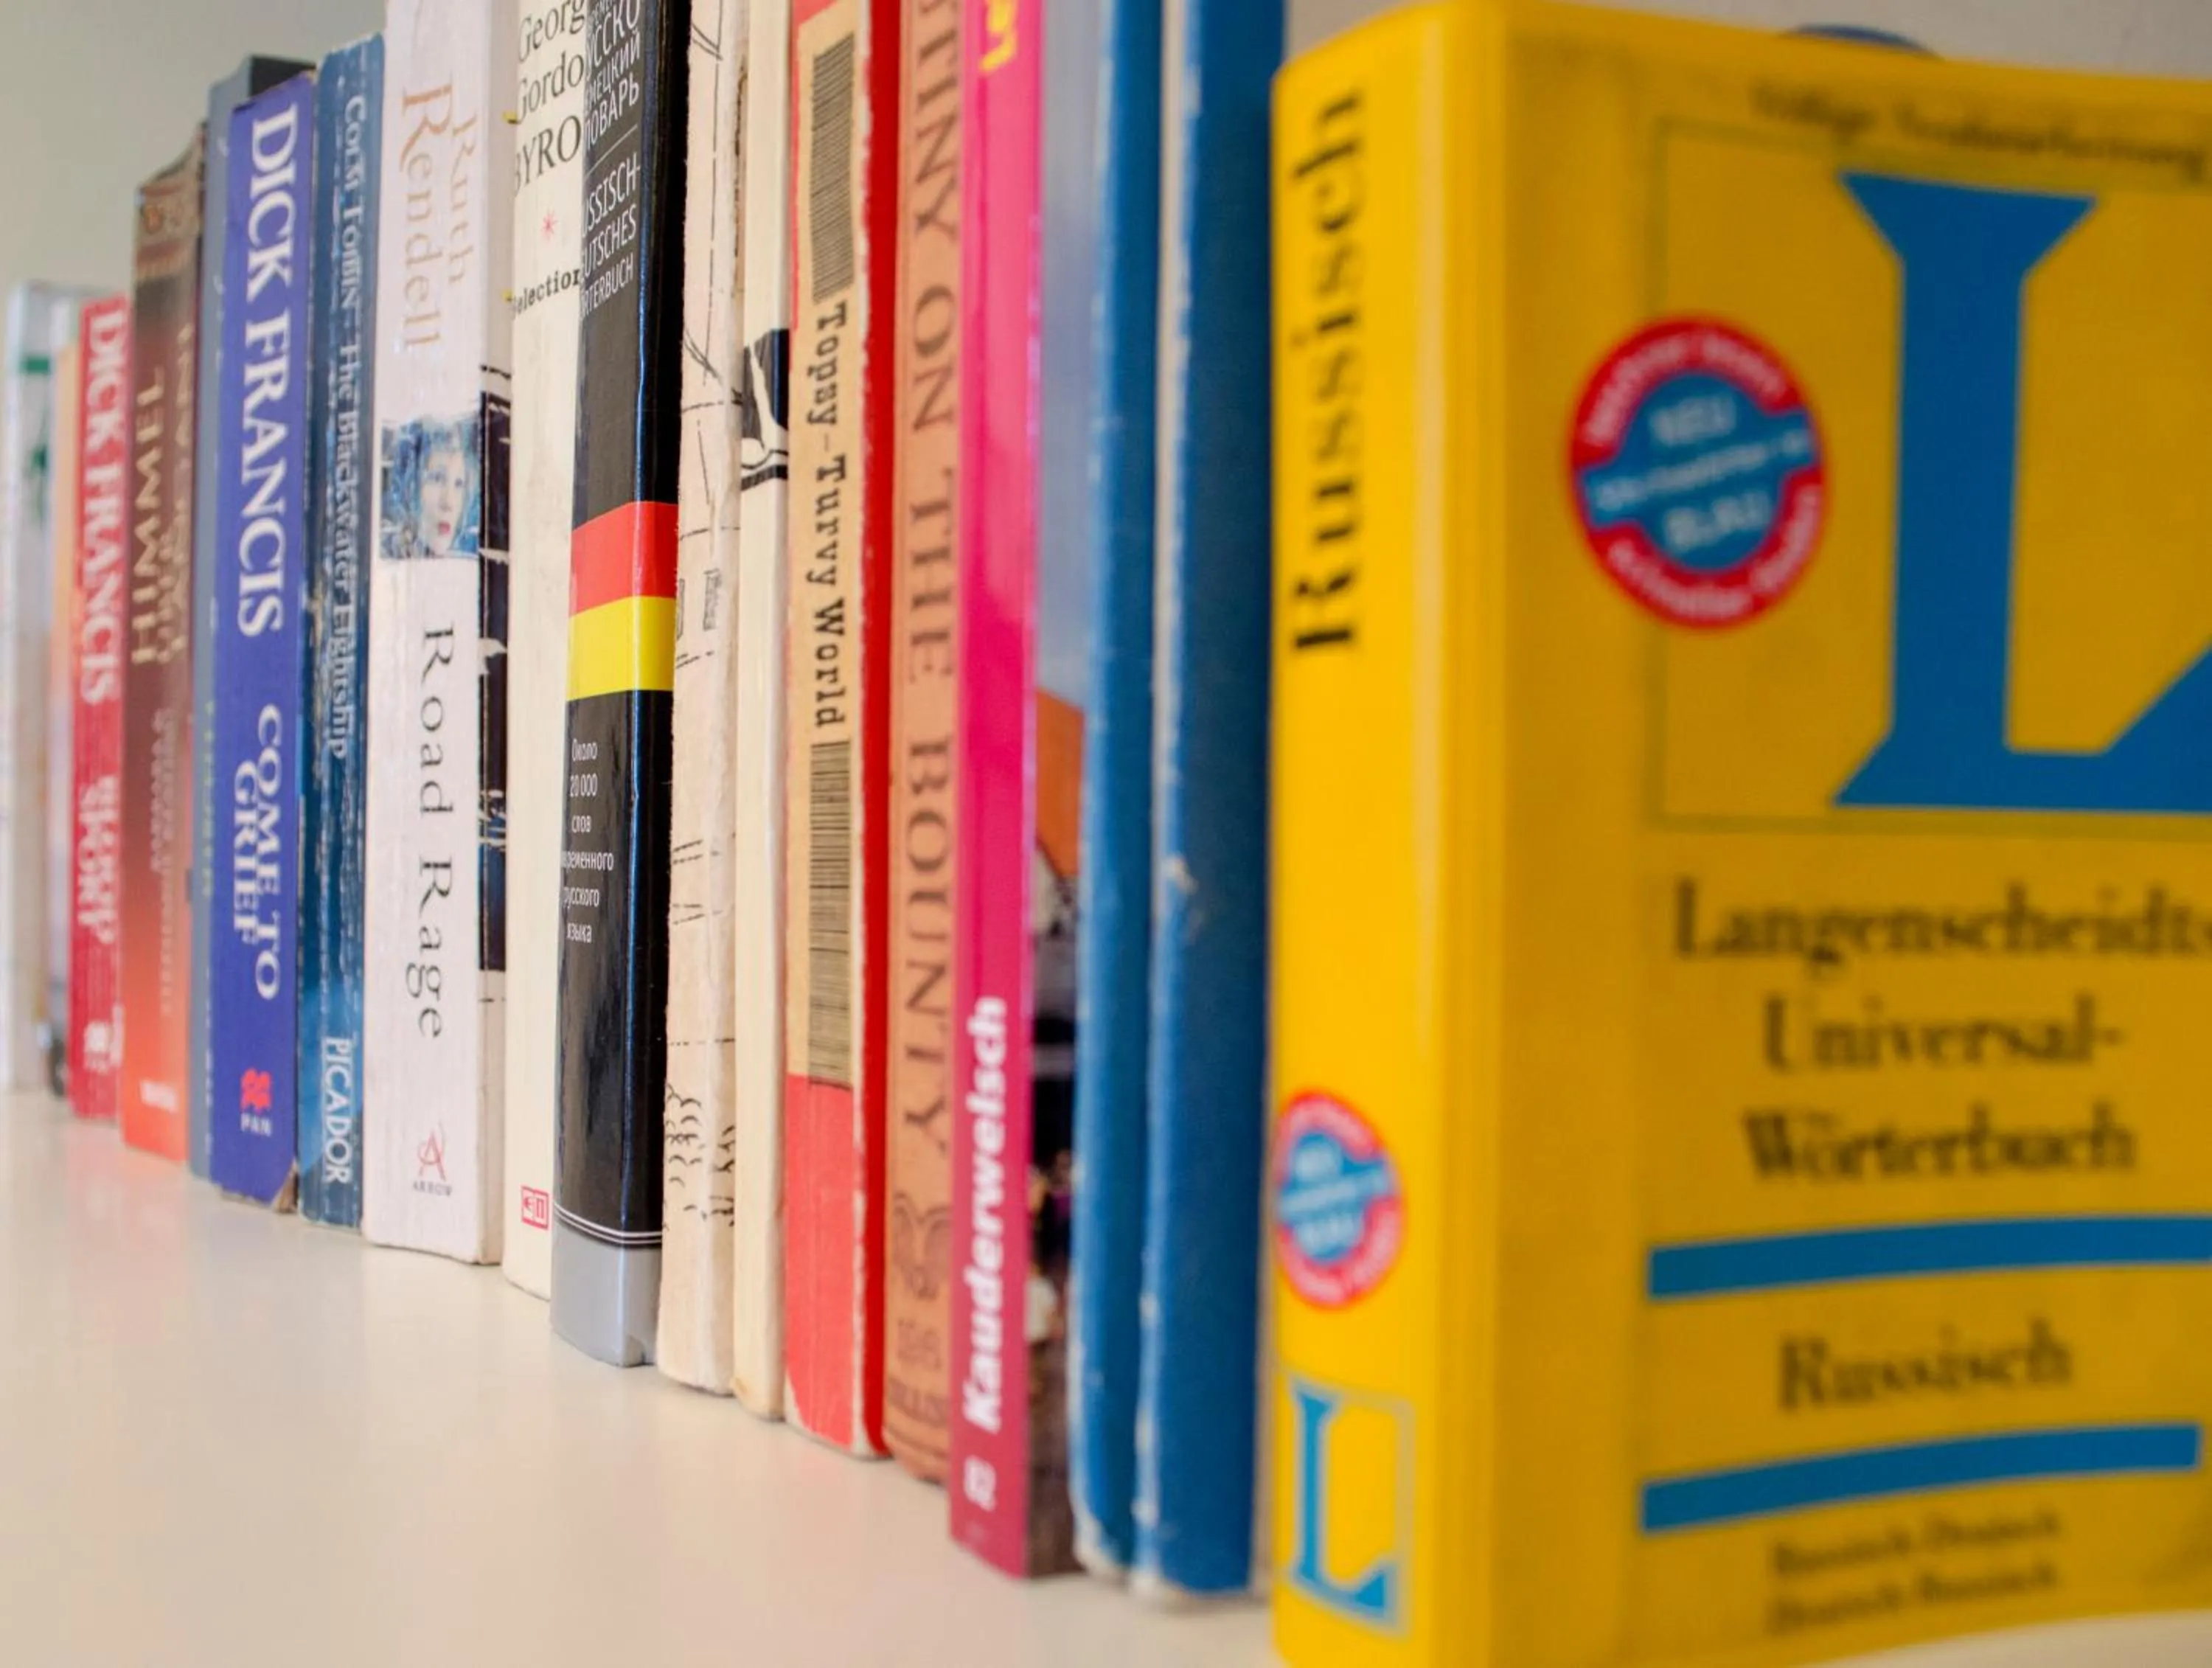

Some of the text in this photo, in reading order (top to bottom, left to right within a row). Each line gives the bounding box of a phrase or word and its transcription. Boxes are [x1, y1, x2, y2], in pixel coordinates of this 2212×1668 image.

[400, 82, 453, 347] Rendell
[448, 112, 478, 284] Ruth
[580, 204, 637, 279] UTSCHES
[913, 0, 960, 244] TINY
[237, 101, 299, 638] DICK FRANCIS
[1290, 90, 1366, 652] Russisch
[80, 311, 124, 706] DICK FRANCIS
[131, 364, 164, 665] HIMMEL
[813, 597, 847, 729] World
[903, 283, 956, 1157] ON THE BOUNTY
[234, 759, 258, 946] GRIEF
[254, 703, 282, 1001] COME TO
[404, 625, 456, 1039] Road Rage
[240, 1111, 274, 1138] PAN
[323, 1035, 355, 1185] PICADOR
[961, 995, 1008, 1434] Kauderwelsch
[1777, 1314, 2076, 1413] Russisch
